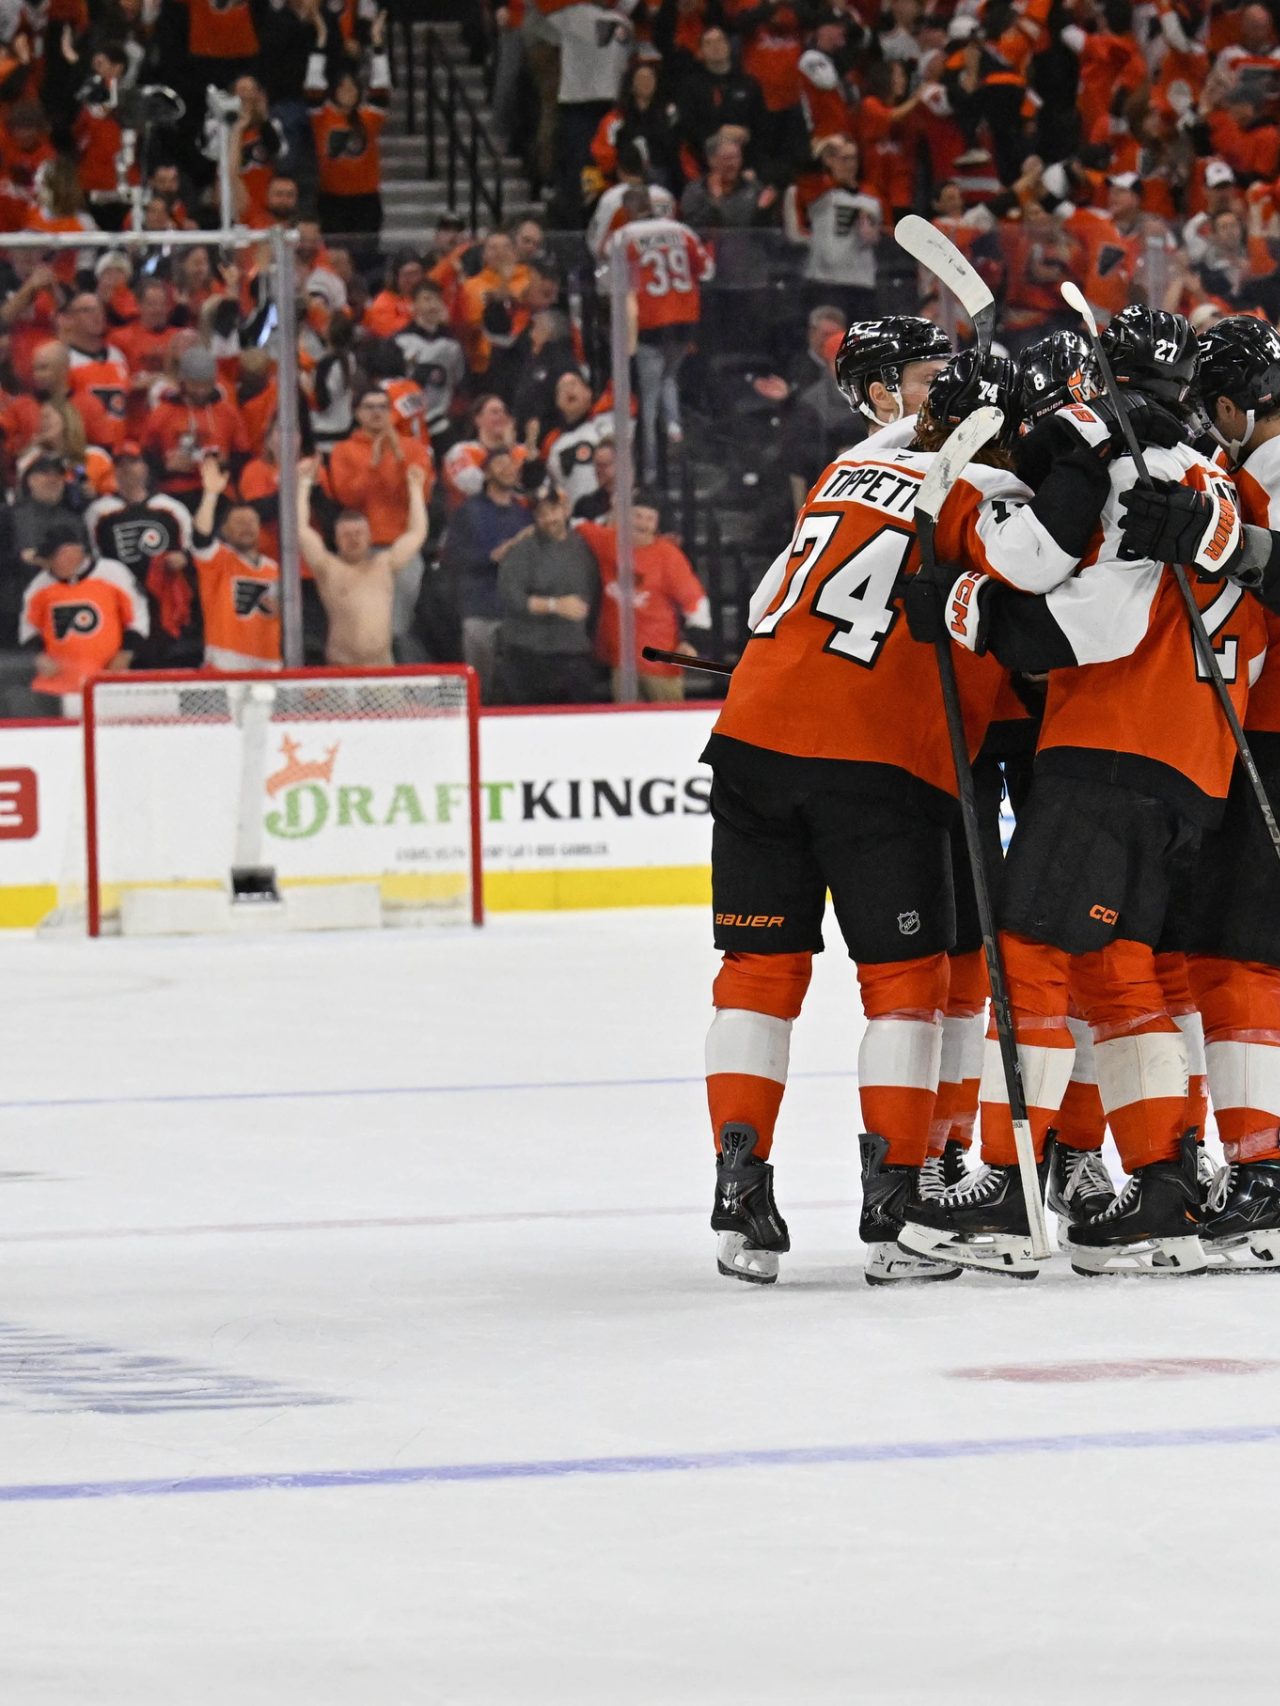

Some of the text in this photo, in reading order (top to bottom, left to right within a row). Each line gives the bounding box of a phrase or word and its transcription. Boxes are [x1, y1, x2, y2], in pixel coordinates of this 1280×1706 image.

[641, 248, 693, 298] 39
[1154, 338, 1178, 363] 27
[978, 380, 999, 403] 74
[1033, 372, 1046, 391] 8
[752, 511, 917, 670] 74
[264, 776, 713, 840] DRAFTKINGS
[715, 913, 785, 928] BAUER
